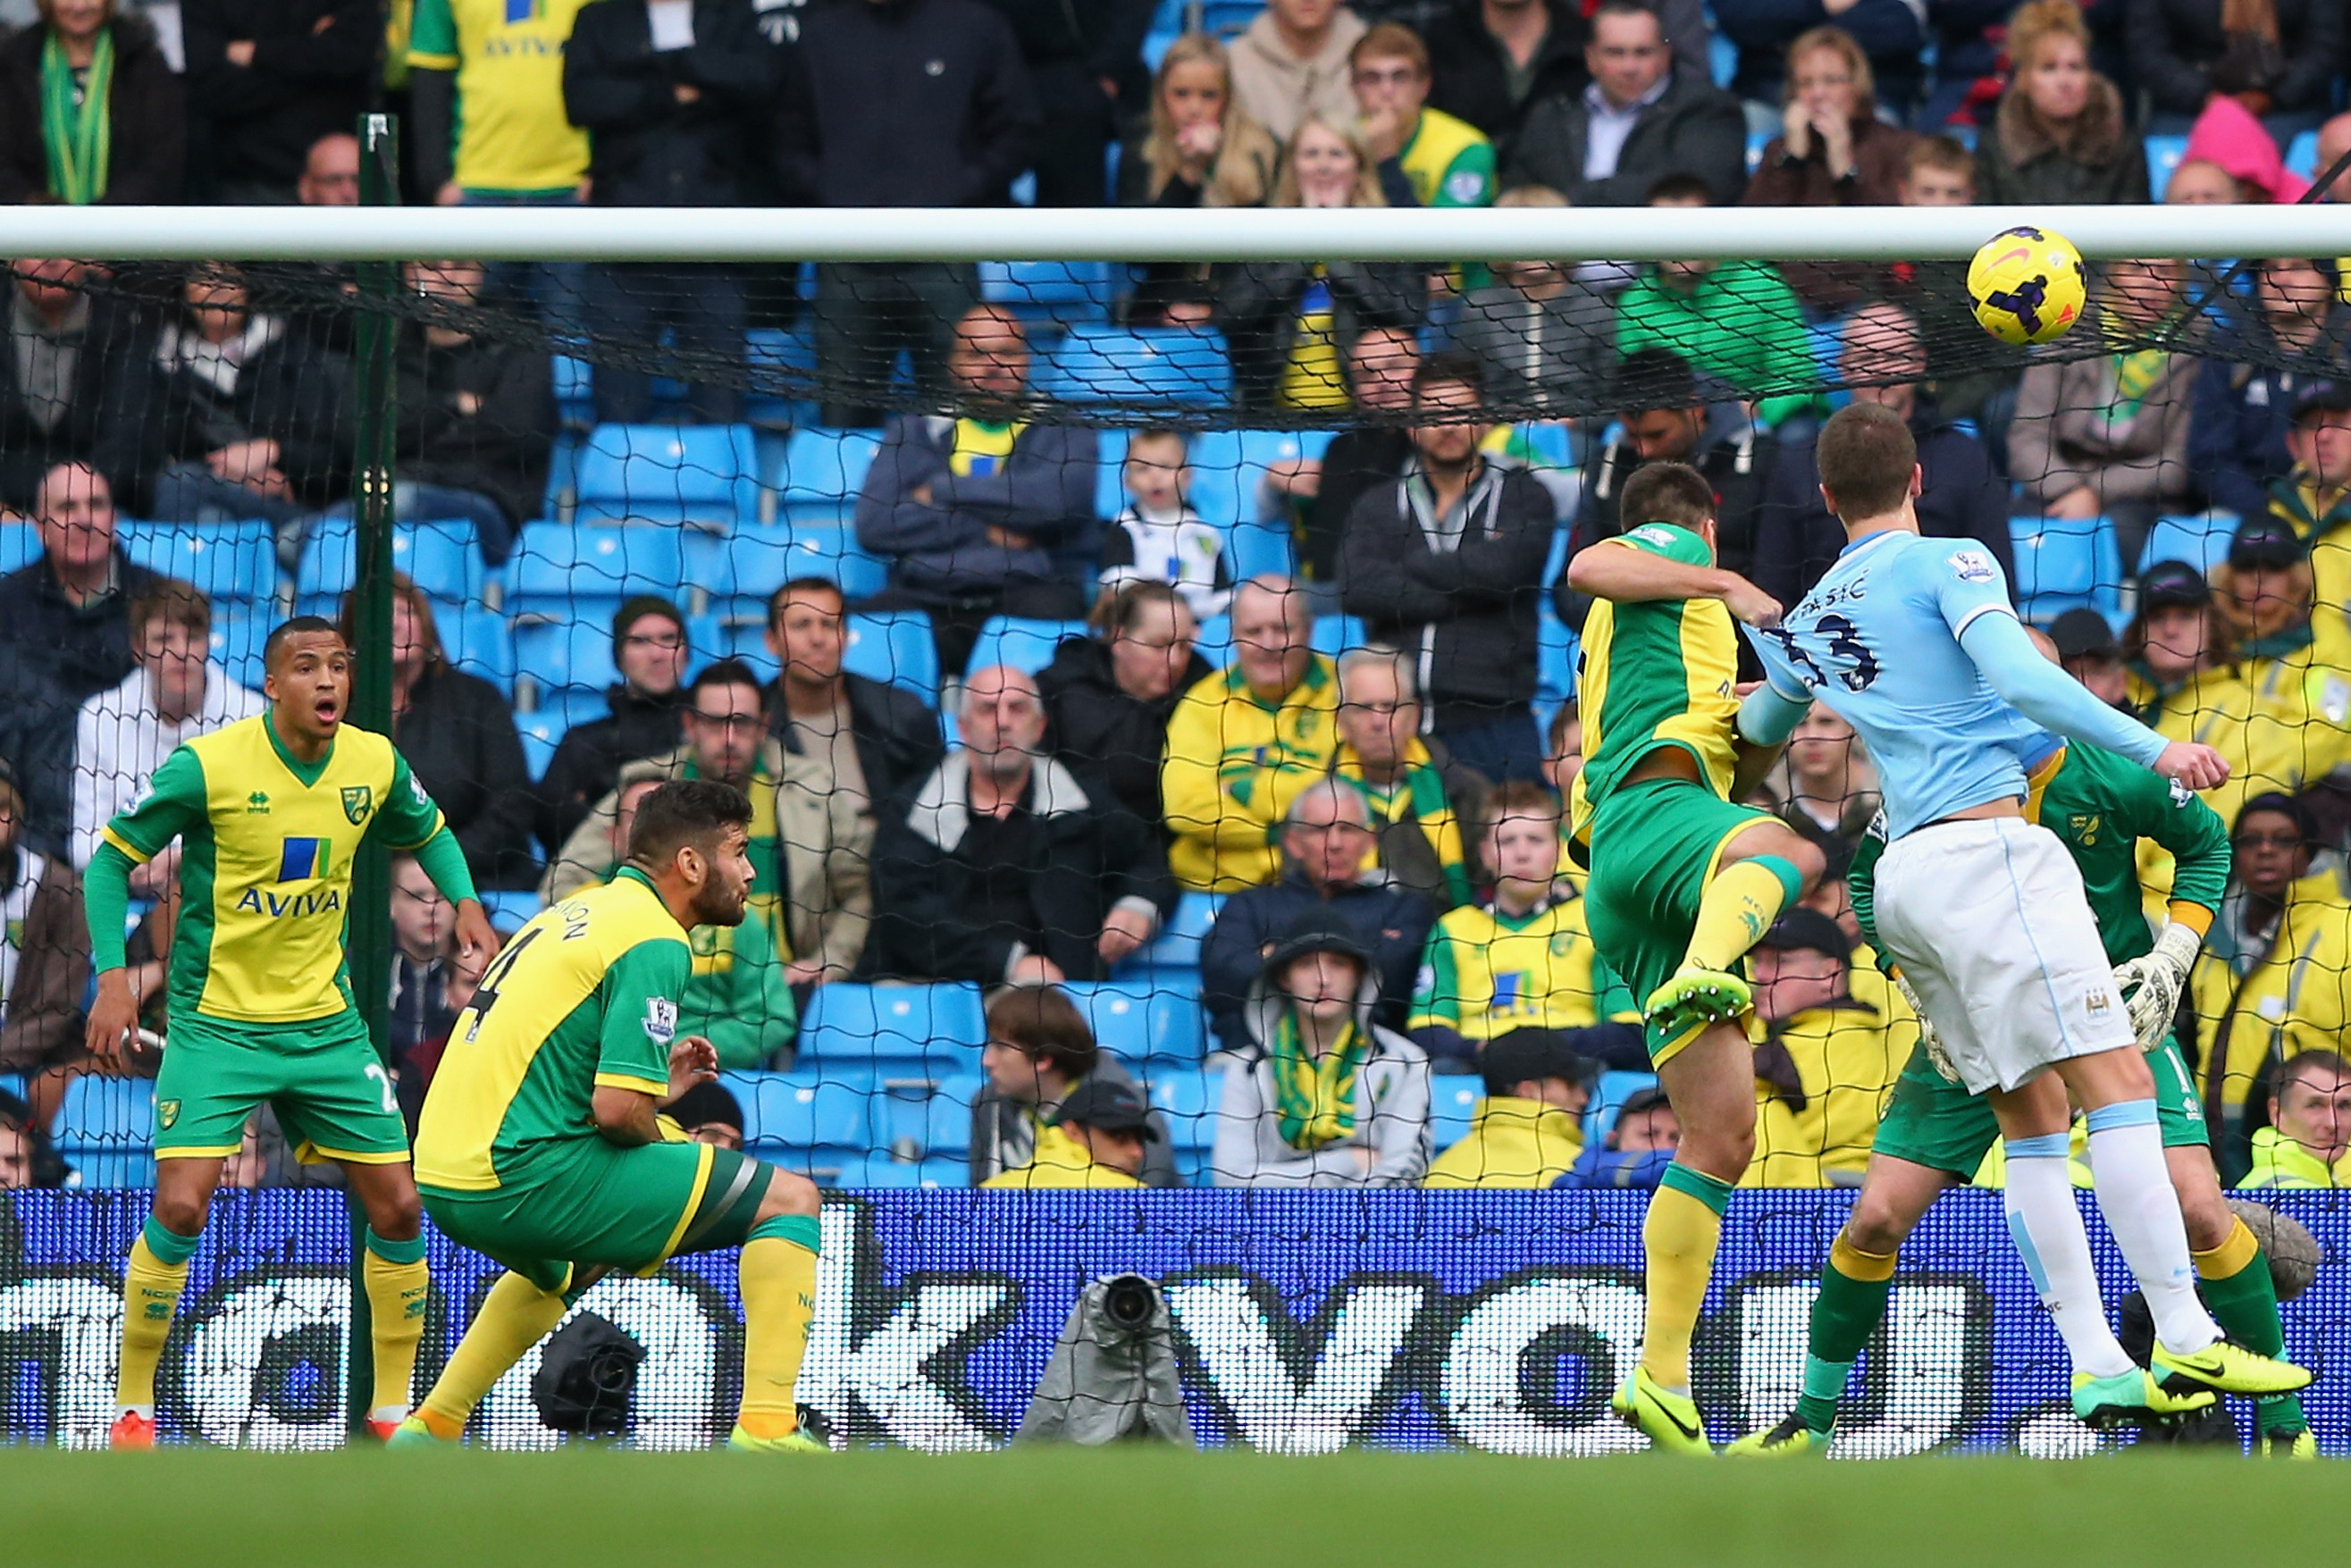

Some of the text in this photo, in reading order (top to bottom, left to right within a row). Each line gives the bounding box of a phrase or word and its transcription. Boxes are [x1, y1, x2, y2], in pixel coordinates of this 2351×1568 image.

[236, 887, 340, 918] AVIVA
[464, 927, 545, 1045] 4
[2163, 1045, 2192, 1094] 1
